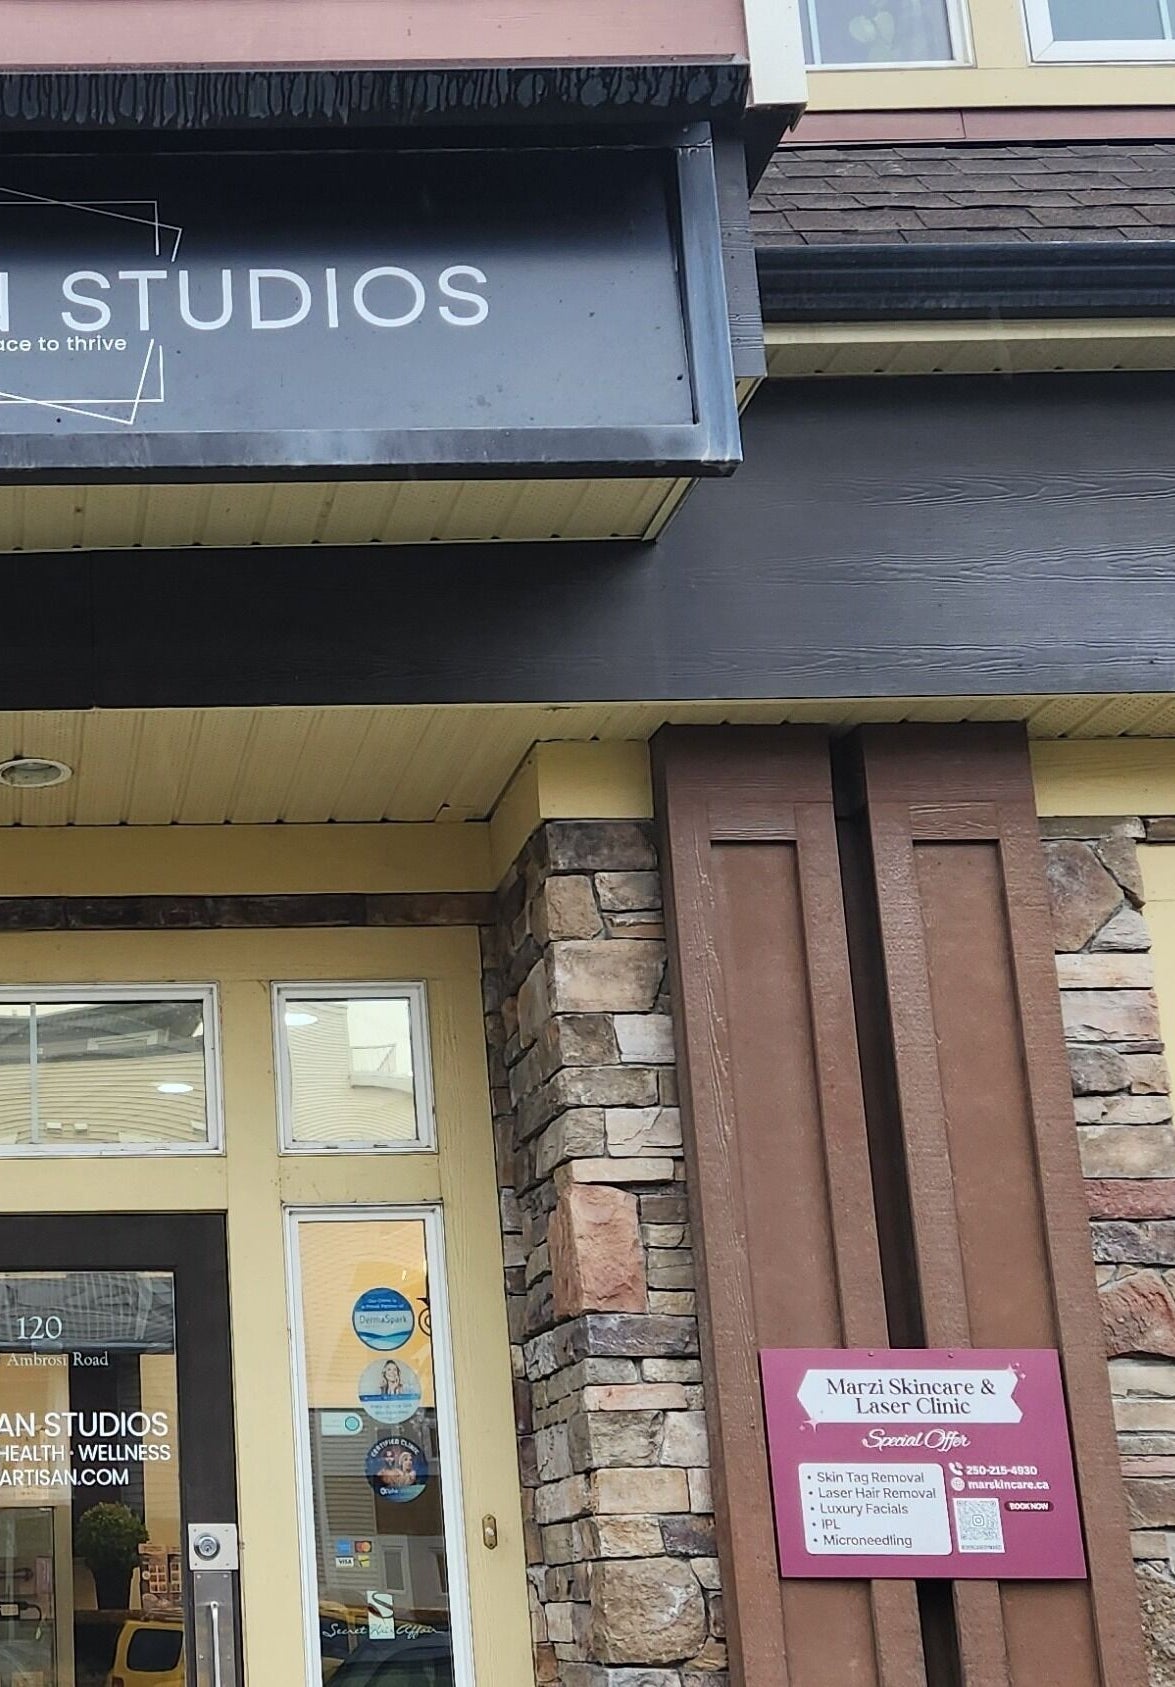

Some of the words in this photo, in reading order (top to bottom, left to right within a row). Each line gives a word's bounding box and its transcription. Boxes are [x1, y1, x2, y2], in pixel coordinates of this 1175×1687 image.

[61, 265, 491, 332] STUDIOS
[38, 336, 60, 351] to
[66, 334, 128, 351] thrive
[17, 1315, 63, 1340] 120
[7, 1351, 68, 1367] Ambrosi
[73, 1351, 109, 1367] Road
[826, 1378, 884, 1395] Marzi
[889, 1377, 974, 1395] Skincare
[980, 1378, 996, 1395] &
[856, 1397, 911, 1414] Laser
[916, 1397, 971, 1414] Clinic
[44, 1411, 169, 1437] STUDIOS
[862, 1428, 923, 1451] Special
[924, 1428, 971, 1452] Offer
[78, 1444, 171, 1462] WELLNESS
[817, 1471, 843, 1483] Skin
[846, 1471, 869, 1484] Tag
[871, 1471, 925, 1483] Removal
[966, 1465, 1038, 1475] 250-215-4930
[967, 1479, 1050, 1490] marskincare.ca
[818, 1487, 853, 1498] Laser
[855, 1487, 881, 1499] Hair
[883, 1487, 937, 1499] Removal
[820, 1502, 863, 1516] Luxury
[865, 1502, 909, 1515] Facials
[821, 1518, 841, 1530] IPL
[823, 1533, 913, 1549] Microneedling
